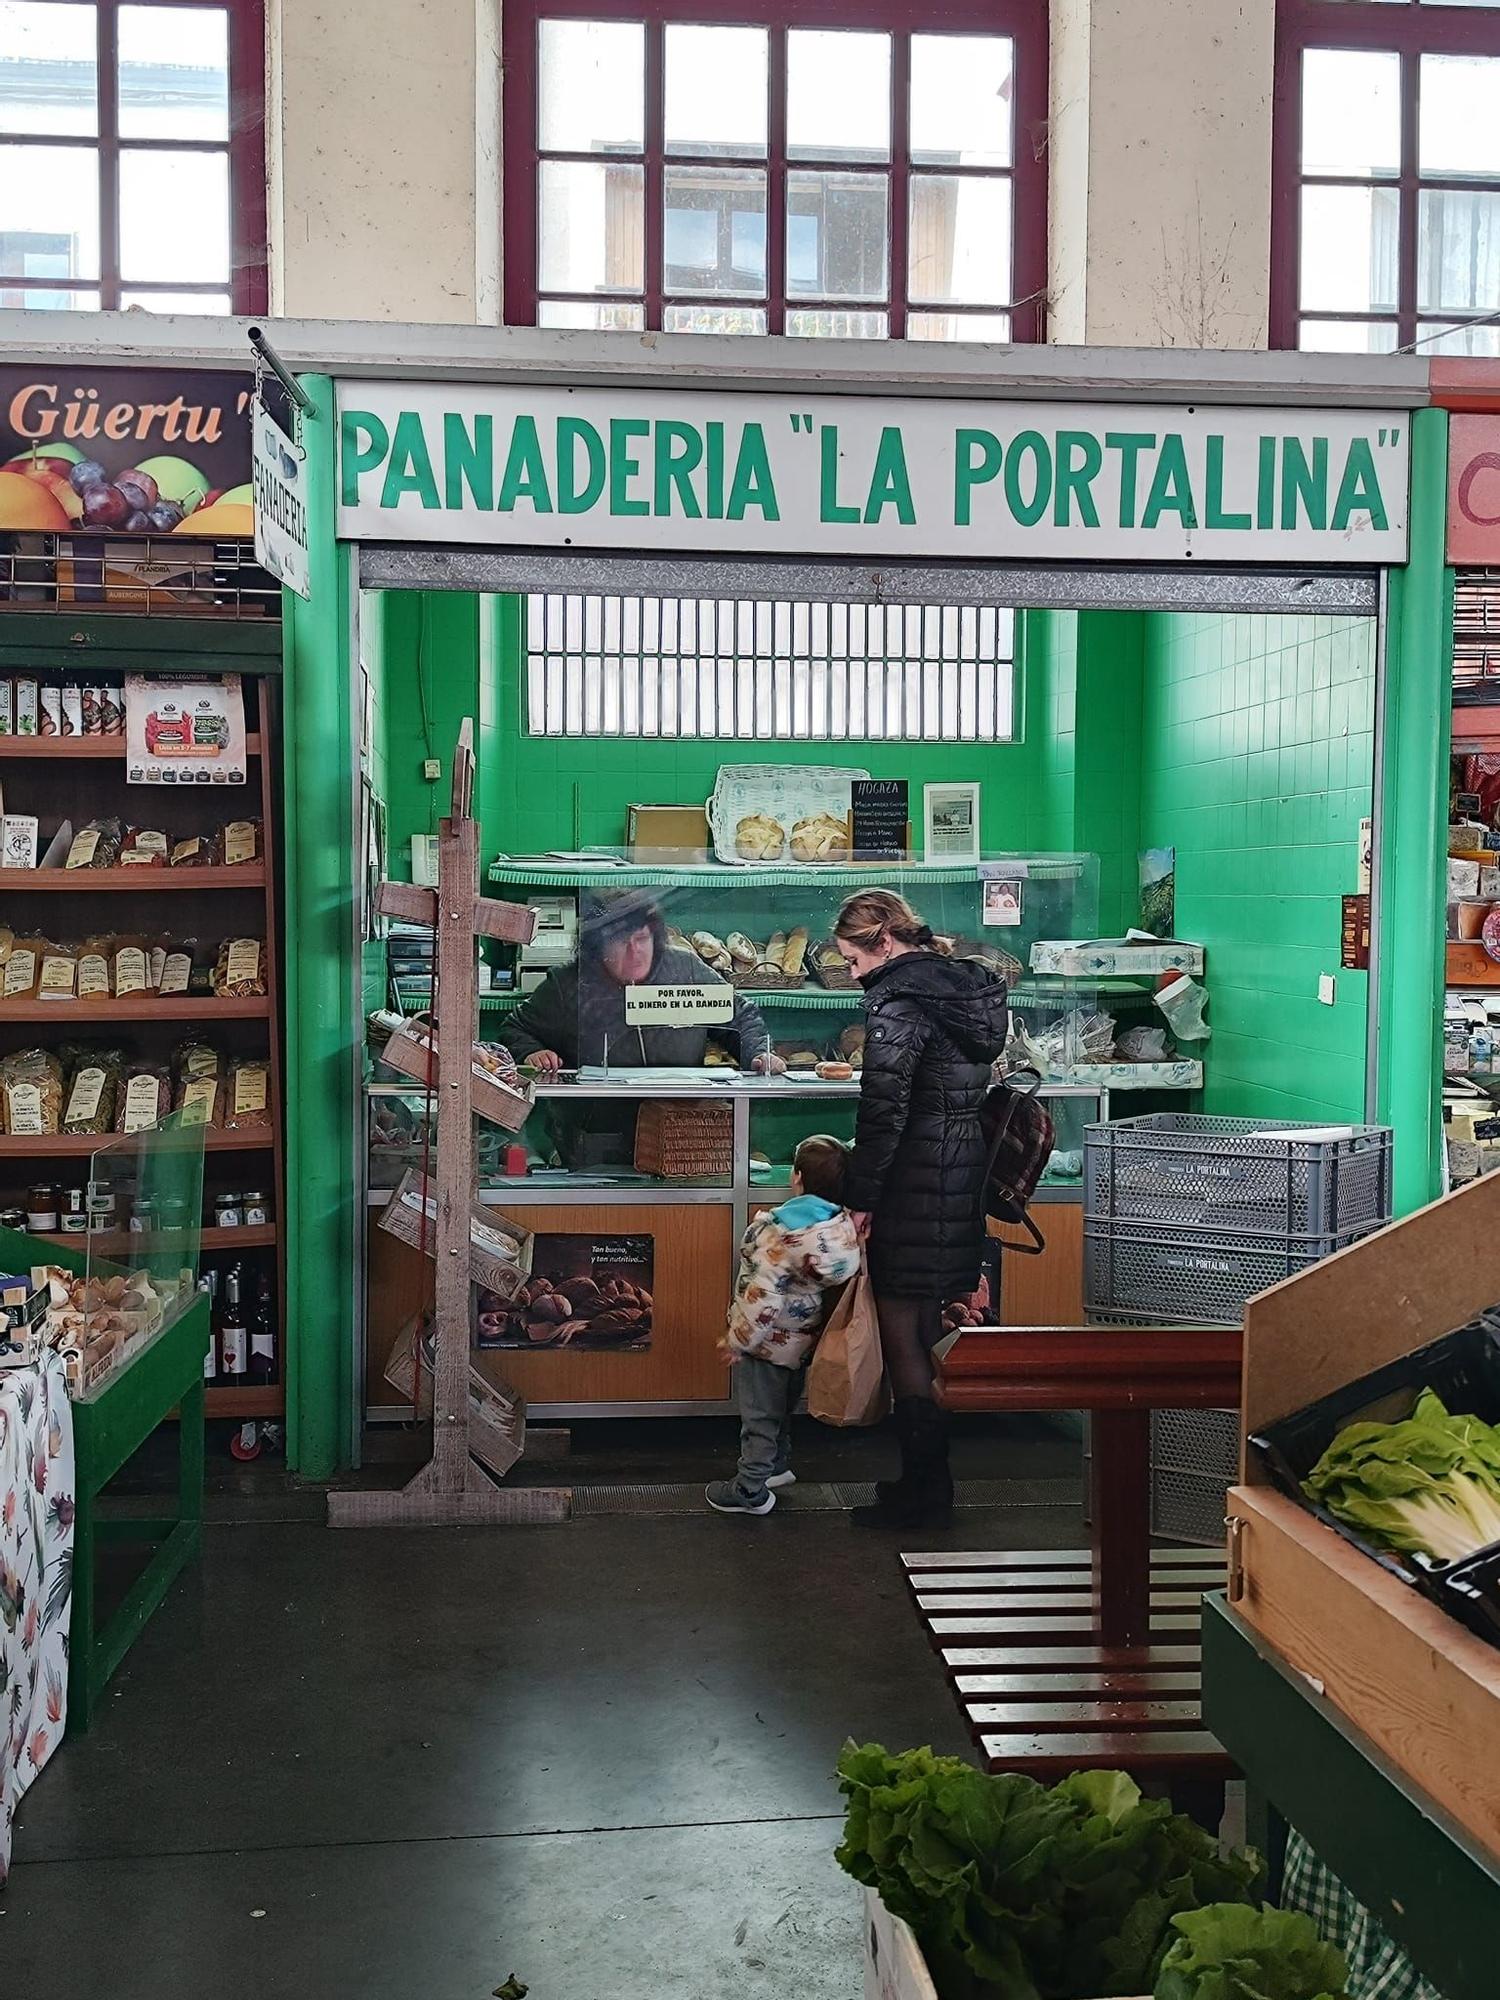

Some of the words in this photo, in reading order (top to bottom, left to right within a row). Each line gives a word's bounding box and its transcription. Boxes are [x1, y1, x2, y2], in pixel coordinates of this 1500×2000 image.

[341, 410, 781, 522] PANADERIA
[789, 413, 917, 524] "LA
[954, 427, 1401, 531] PORTALINA"
[253, 454, 309, 551] PANADERIA
[857, 781, 899, 796] HOGAZA
[658, 989, 674, 997] POR
[627, 1001, 636, 1009] EL
[638, 1001, 667, 1009] DINERO
[683, 1000, 693, 1008] LA
[696, 1000, 732, 1008] BANDEJA
[1186, 1164, 1194, 1174] LA
[592, 1245, 604, 1253] Tan
[1185, 1258, 1193, 1268] LA
